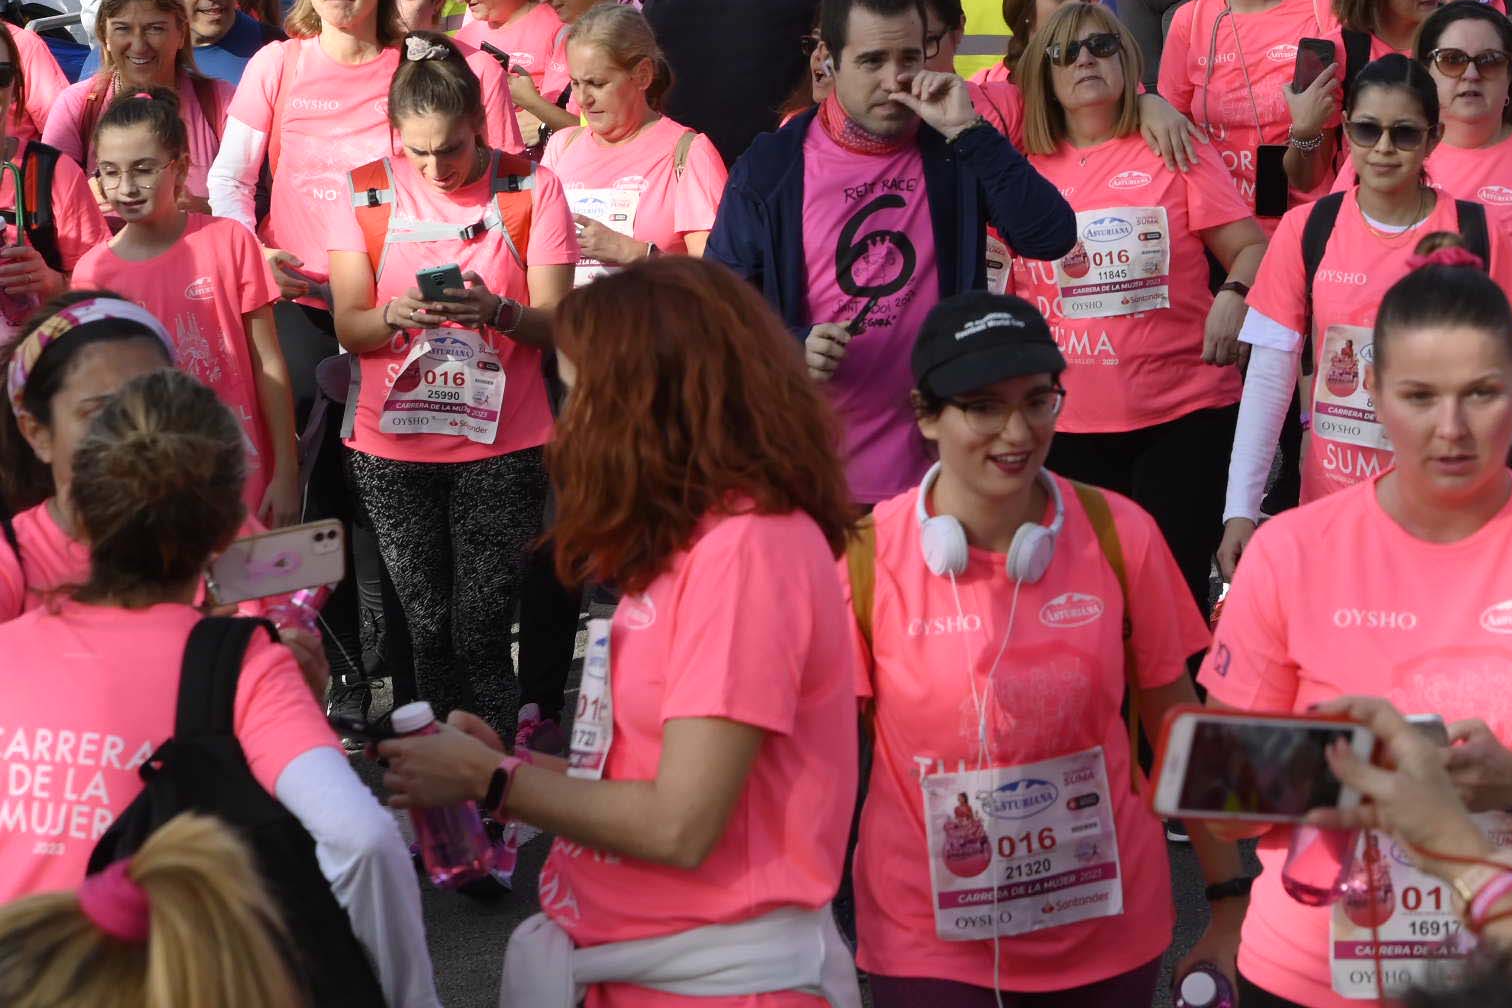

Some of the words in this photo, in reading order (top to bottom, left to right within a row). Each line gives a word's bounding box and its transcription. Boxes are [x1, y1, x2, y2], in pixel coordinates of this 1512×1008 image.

[292, 98, 339, 111] OYSHO
[313, 188, 337, 201] NO
[1086, 225, 1130, 238] ASTURIANA
[835, 194, 917, 298] 6
[1093, 249, 1130, 267] 016
[1098, 269, 1128, 282] 11845
[1073, 286, 1101, 294] CARRERA
[1071, 301, 1103, 312] OYSHO
[424, 369, 466, 386] 016
[428, 389, 460, 401] 25990
[396, 402, 428, 410] CARRERA
[1327, 406, 1363, 418] CARRERA
[392, 416, 430, 426] OYSHO
[1321, 421, 1361, 436] OYSHO
[908, 615, 982, 636] OYSHO
[1334, 608, 1417, 631] OYSHO
[8, 762, 54, 798] DE
[64, 767, 110, 804] LA
[1063, 771, 1095, 786] SUMA
[997, 827, 1057, 859] 016
[1005, 858, 1051, 880] 21320
[1056, 890, 1110, 912] Santander
[1401, 887, 1442, 911] 01
[1408, 920, 1461, 937] 16917
[1350, 969, 1413, 985] OYHO
